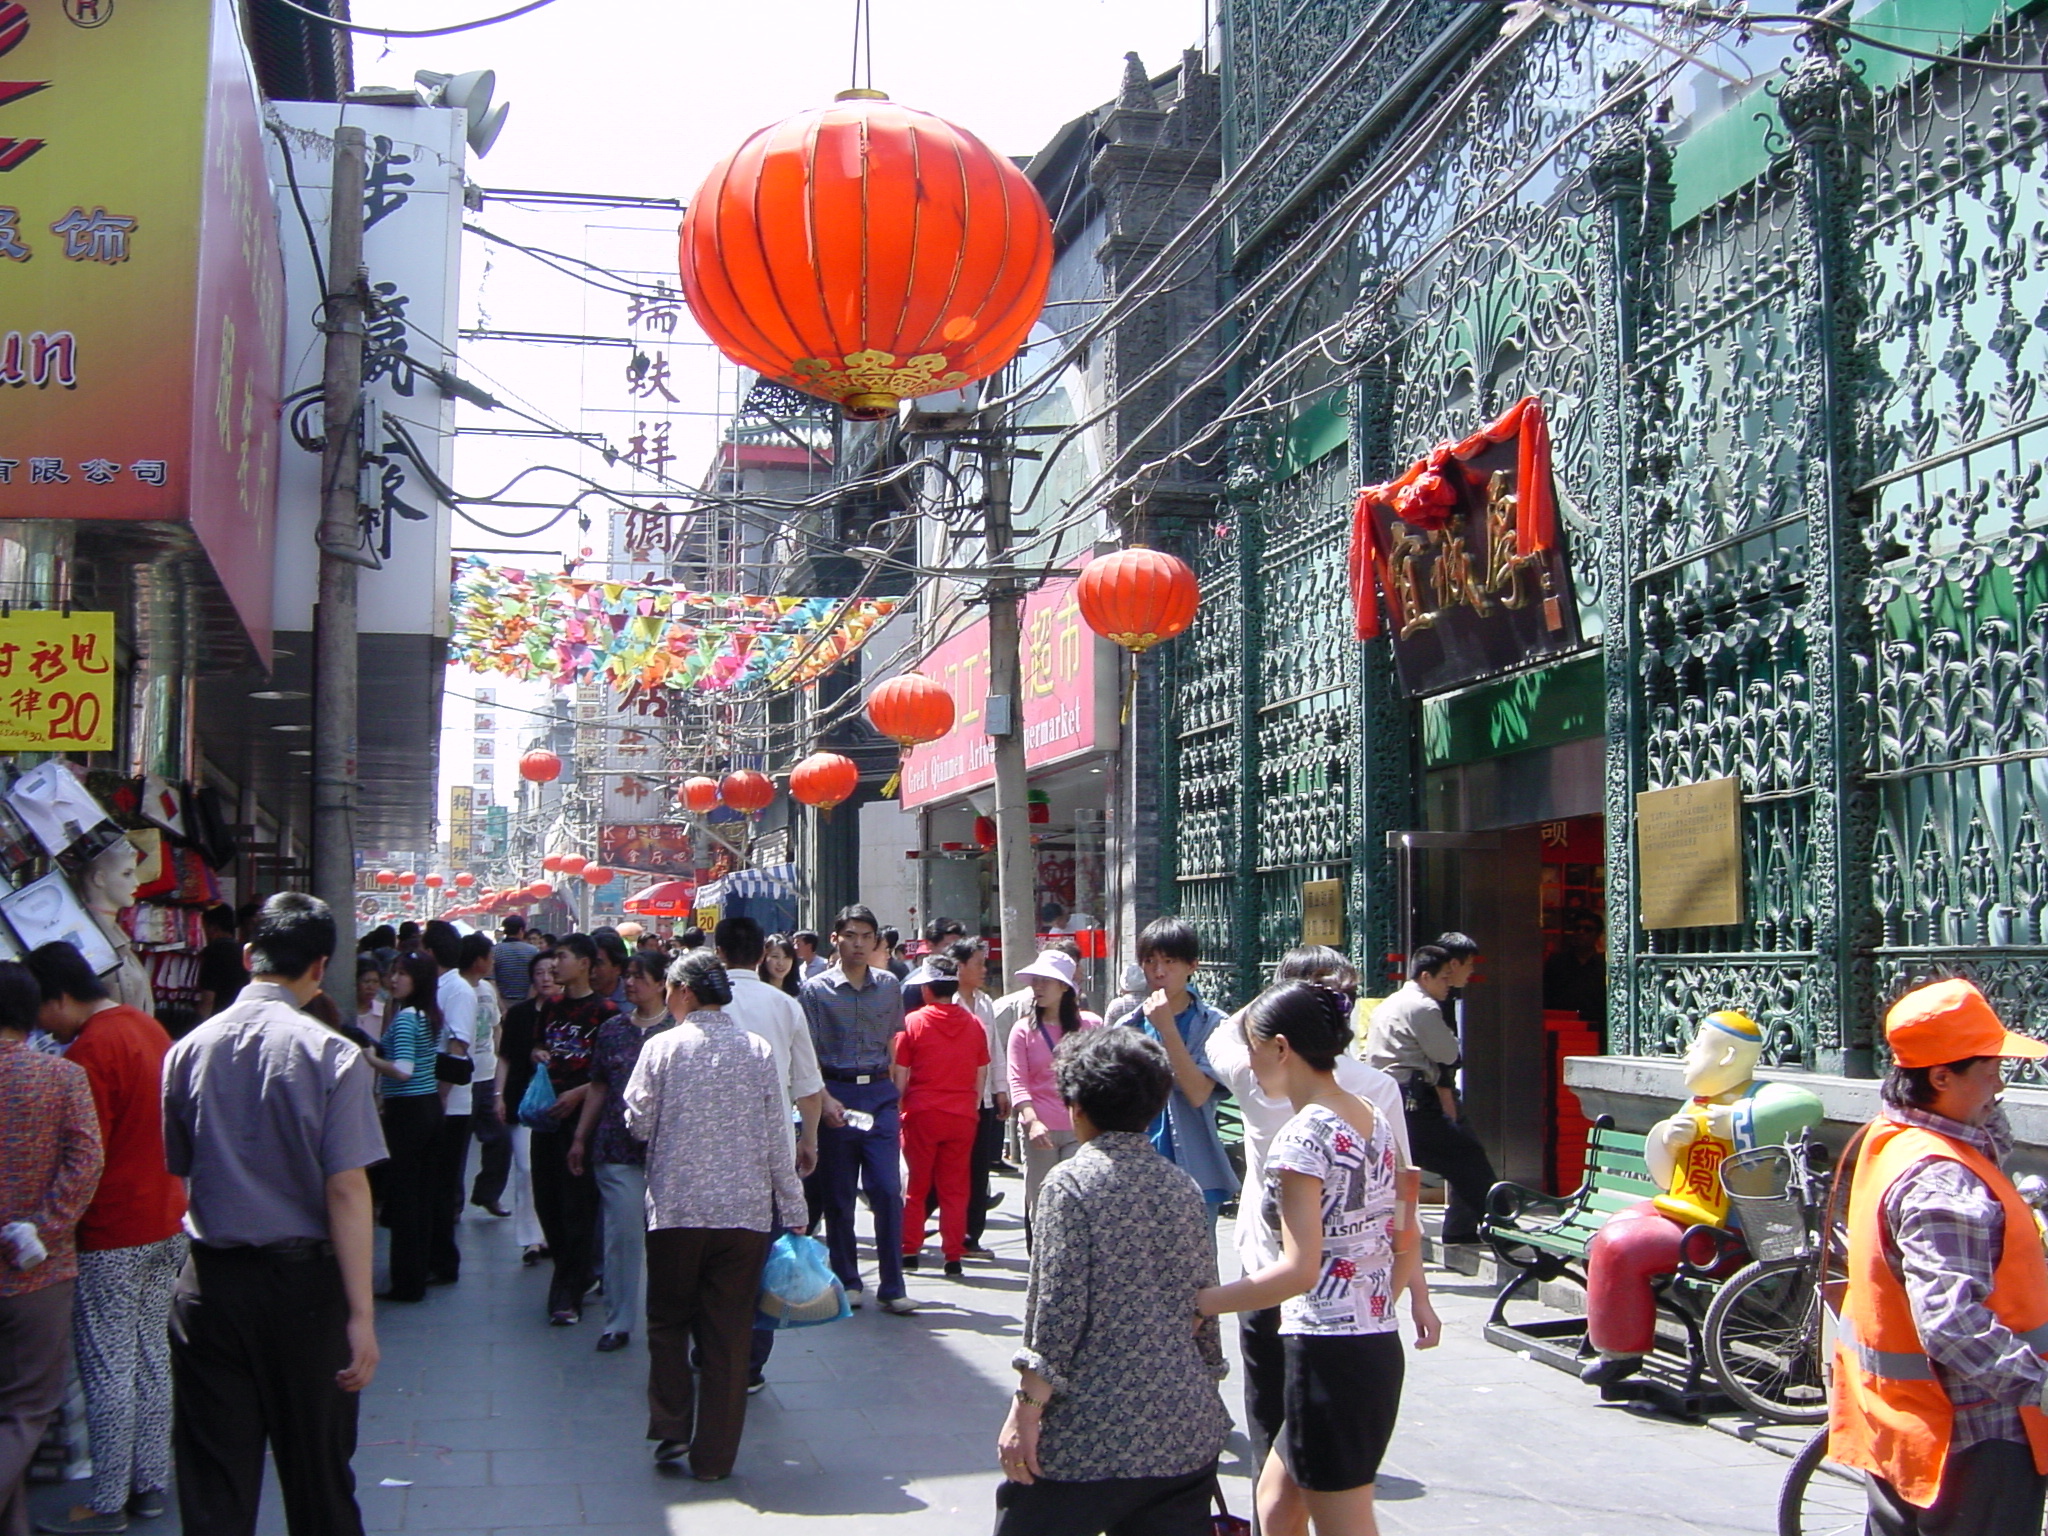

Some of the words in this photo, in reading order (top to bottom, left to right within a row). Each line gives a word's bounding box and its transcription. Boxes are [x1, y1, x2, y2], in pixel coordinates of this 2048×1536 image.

[907, 763, 928, 794] Great
[930, 754, 964, 789] Qianmen
[968, 738, 995, 772] Artwo
[1023, 701, 1081, 759] permarket
[603, 826, 616, 863] KTV
[699, 916, 715, 931] 20
